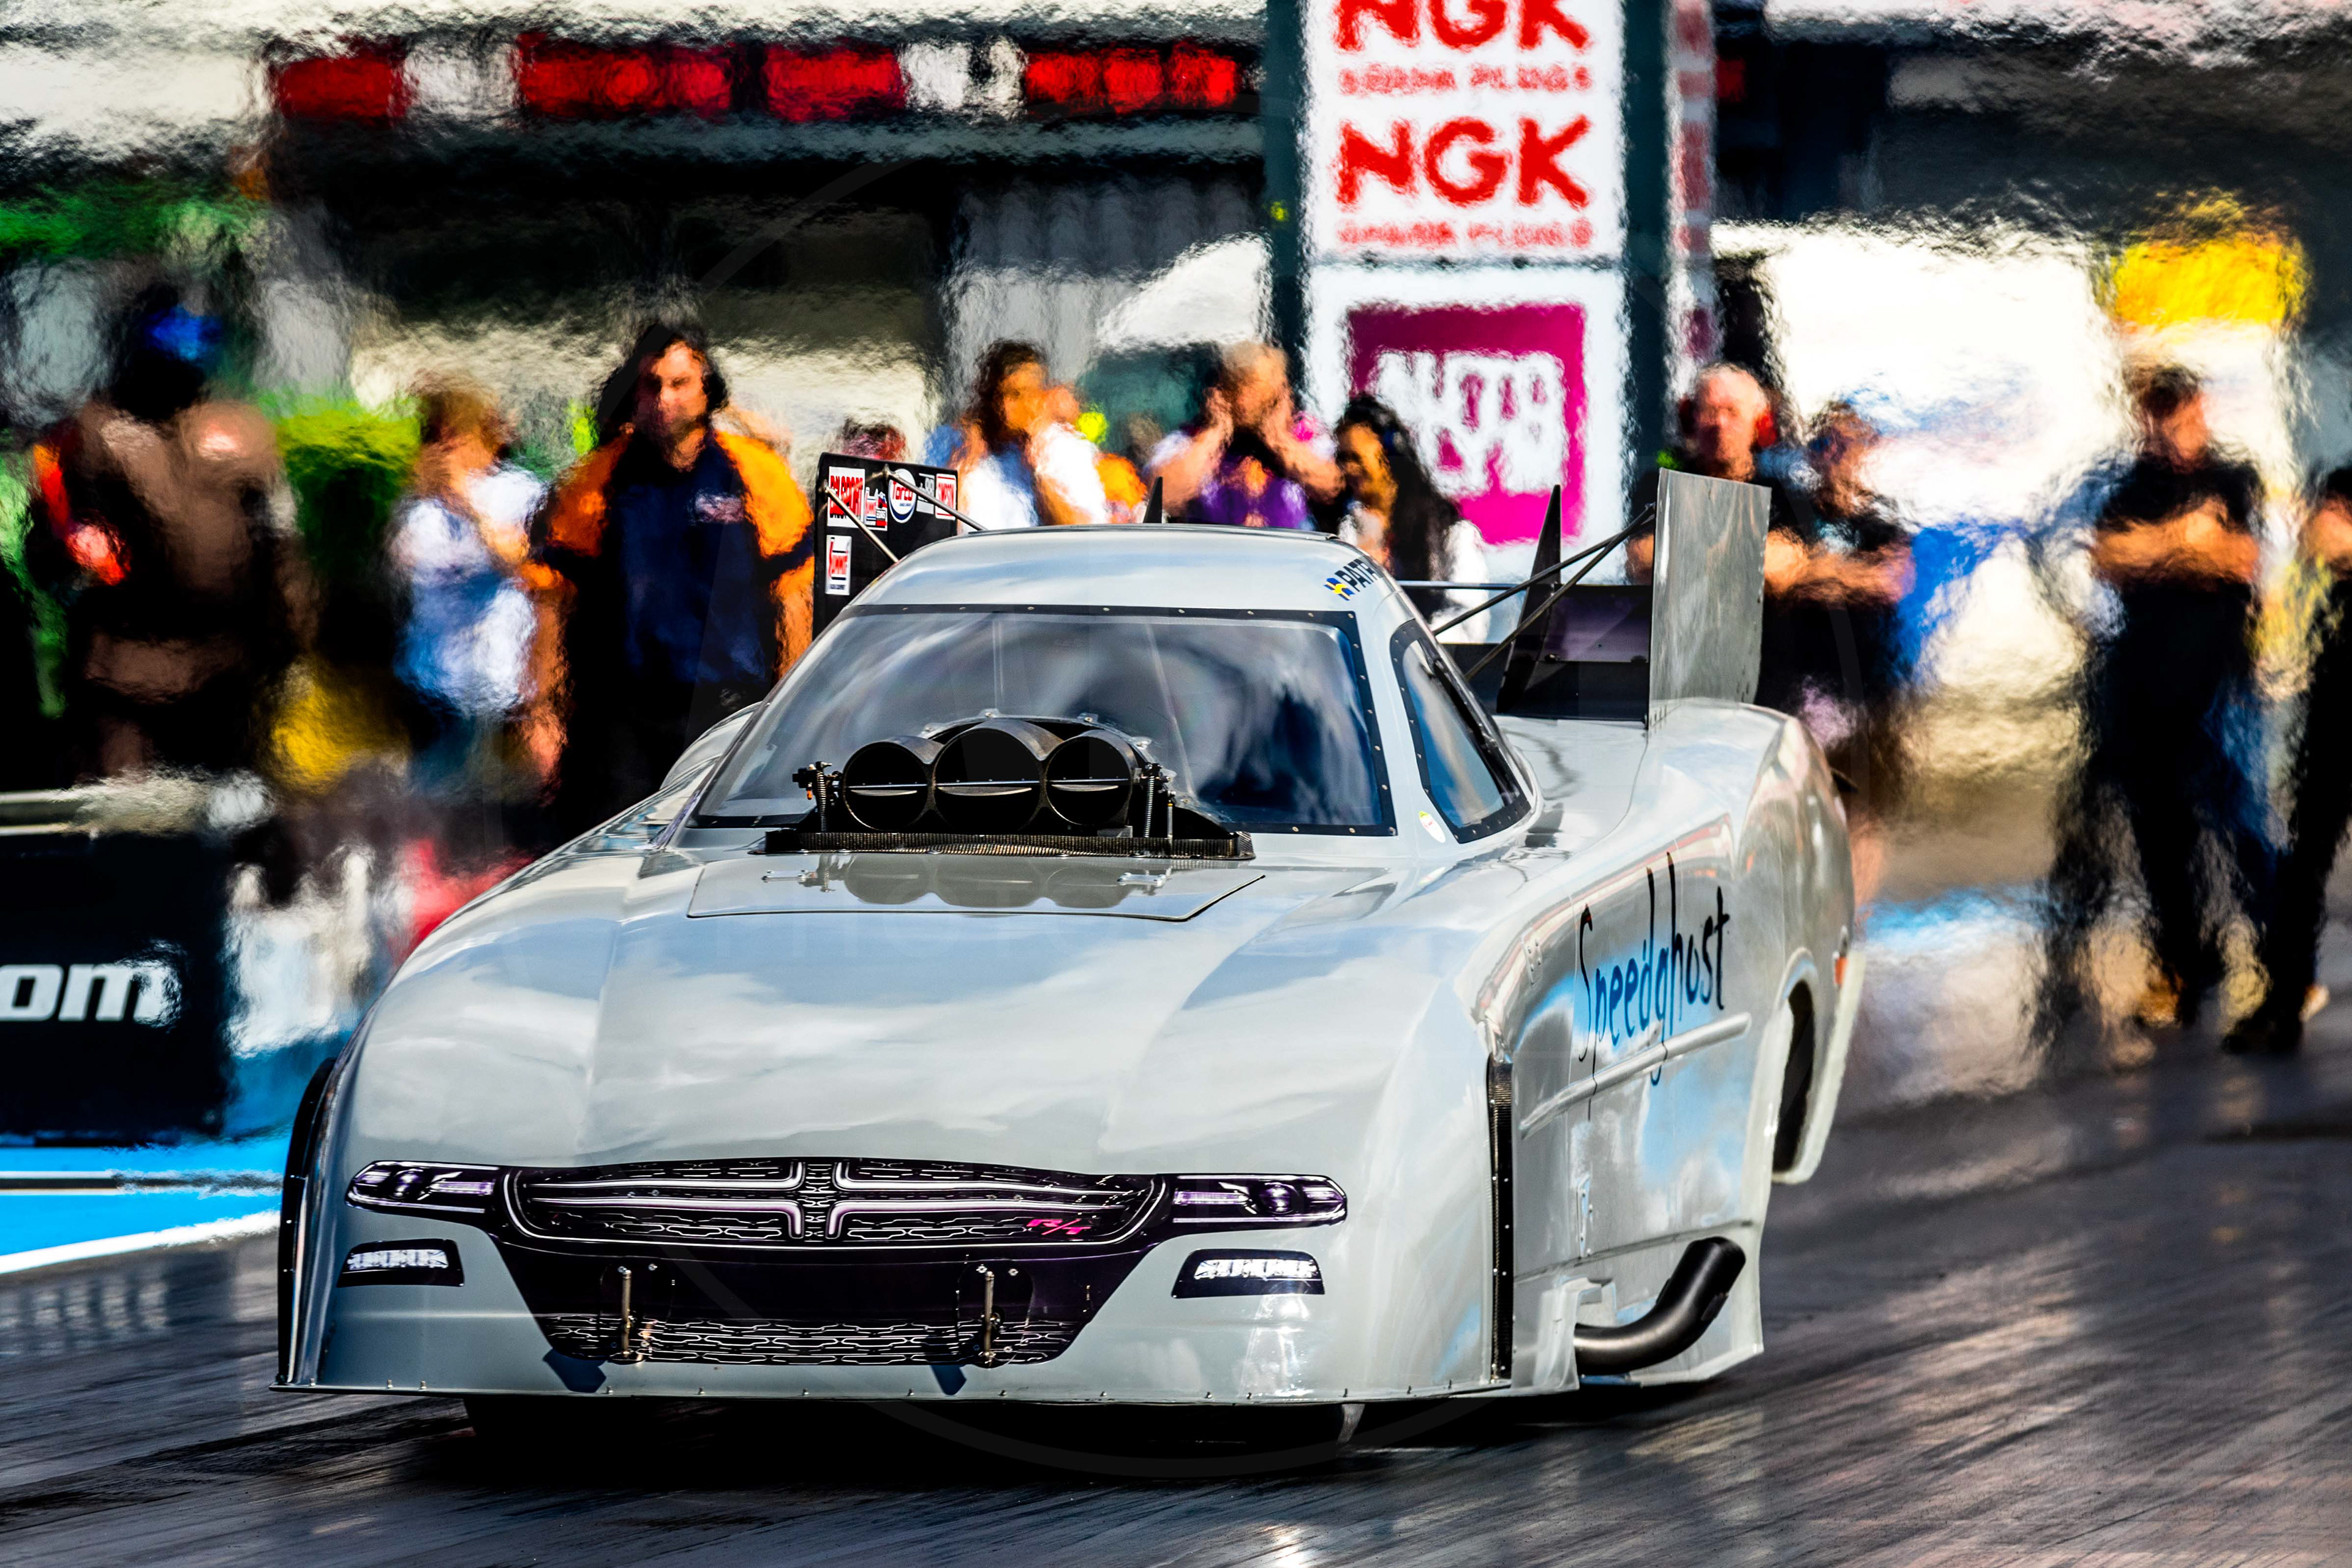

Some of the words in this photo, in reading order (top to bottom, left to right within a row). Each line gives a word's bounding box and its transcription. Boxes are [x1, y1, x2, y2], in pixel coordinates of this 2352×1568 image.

[1335, 0, 1593, 51] NGK
[1335, 114, 1593, 208] NGK
[1578, 851, 1730, 1121] Speedghost
[1026, 1218, 1091, 1235] R/T
